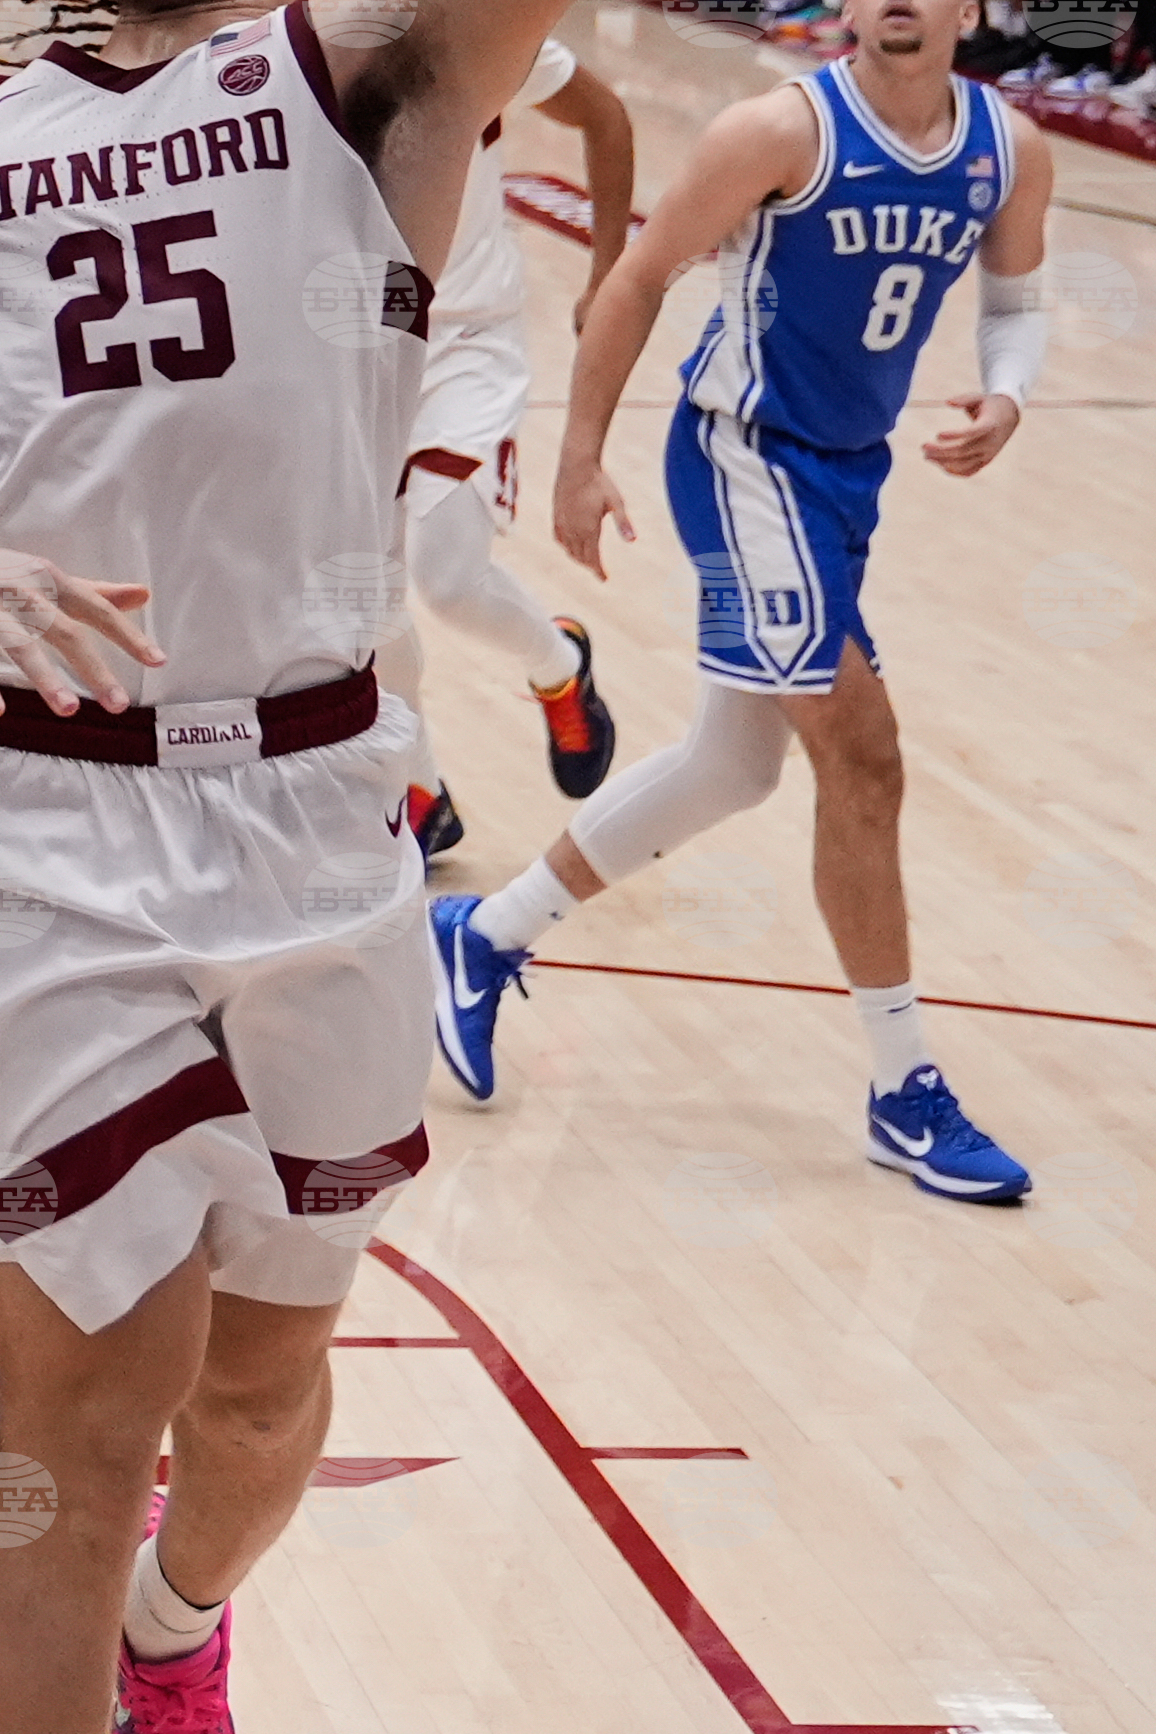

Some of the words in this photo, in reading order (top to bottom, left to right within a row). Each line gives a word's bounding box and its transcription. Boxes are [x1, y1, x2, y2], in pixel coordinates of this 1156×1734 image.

[825, 204, 986, 265] DUKE
[46, 210, 236, 398] 25
[861, 263, 924, 352] 8
